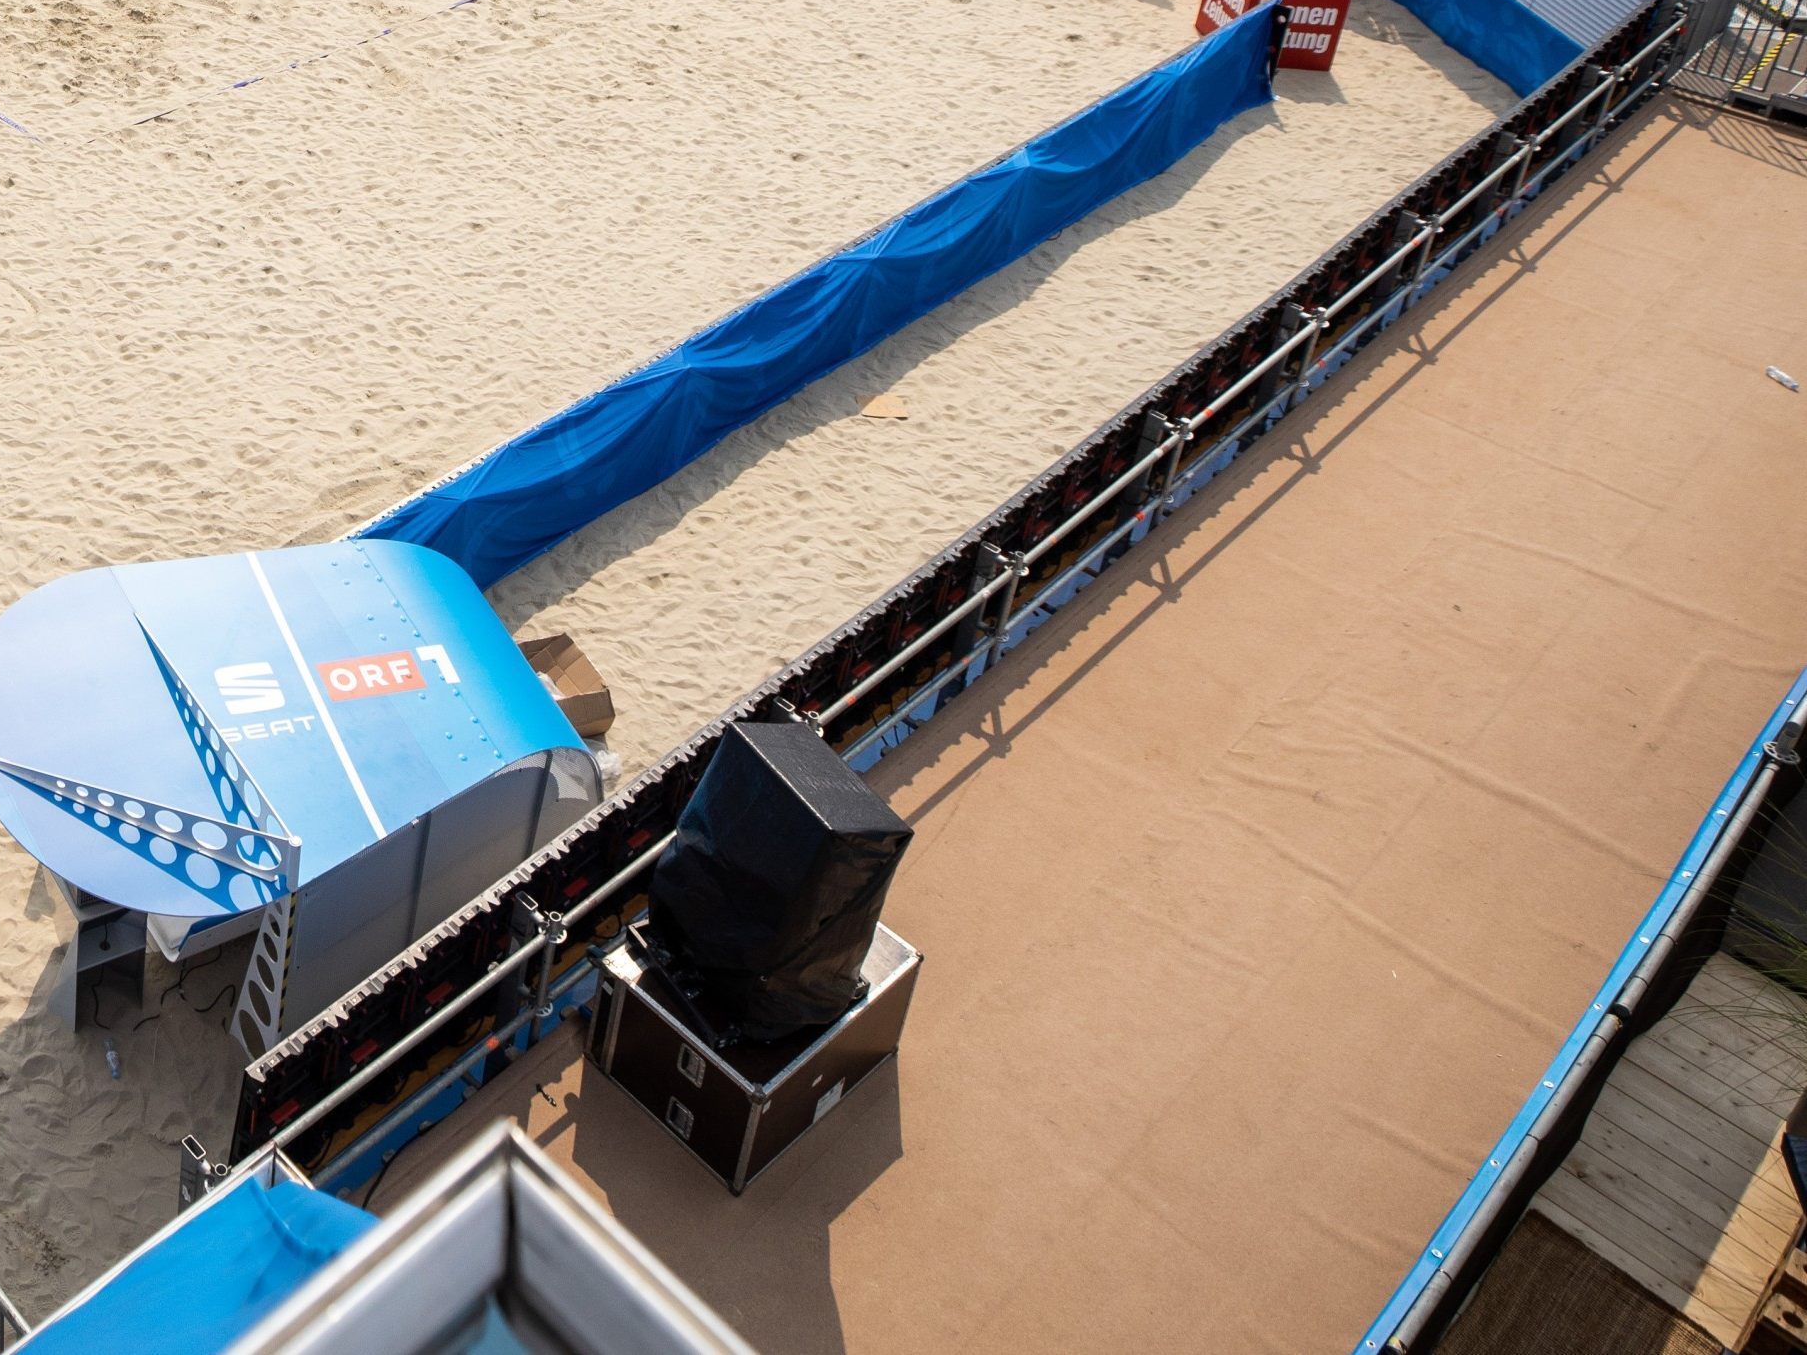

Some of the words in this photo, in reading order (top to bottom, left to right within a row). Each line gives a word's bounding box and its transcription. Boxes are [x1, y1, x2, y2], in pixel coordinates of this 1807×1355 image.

[329, 658, 414, 694] ORF
[416, 644, 461, 685] 1
[220, 714, 316, 745] SEAT
